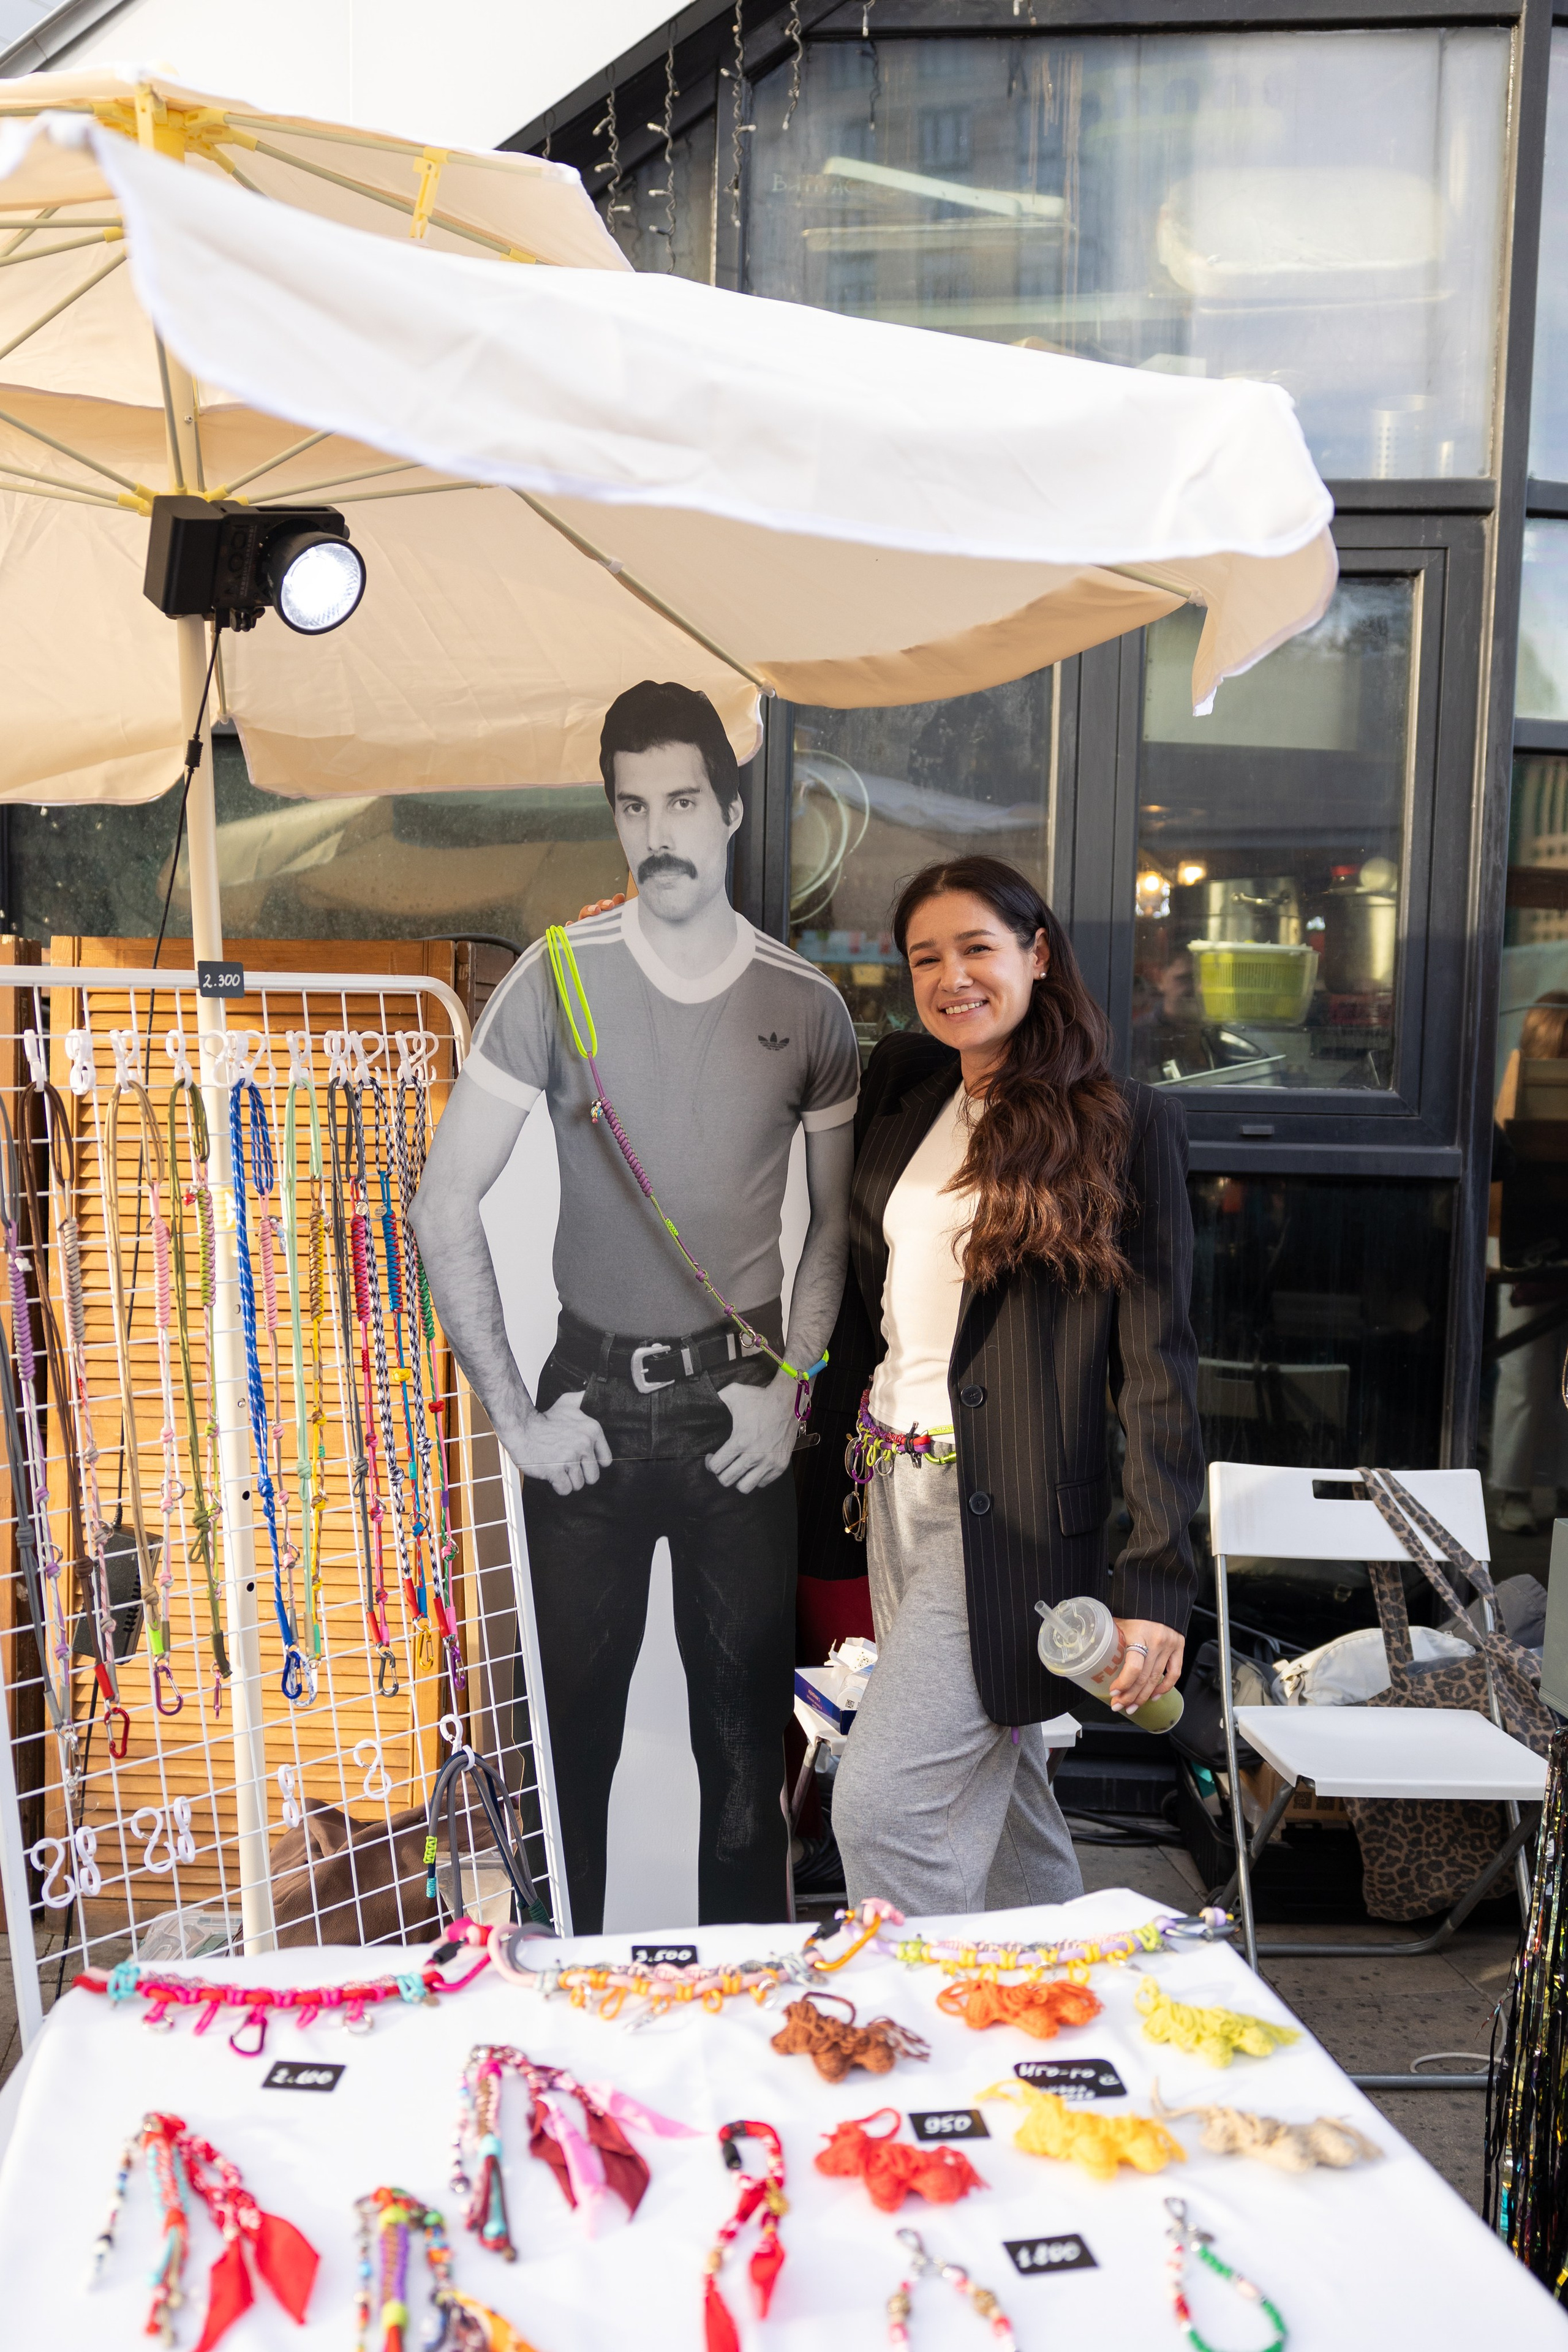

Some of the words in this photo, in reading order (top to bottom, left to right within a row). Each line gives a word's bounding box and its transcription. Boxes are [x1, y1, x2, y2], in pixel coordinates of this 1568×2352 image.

[203, 973, 241, 989] 2.300
[636, 1949, 692, 1962] 3.500
[924, 2114, 972, 2134] 950
